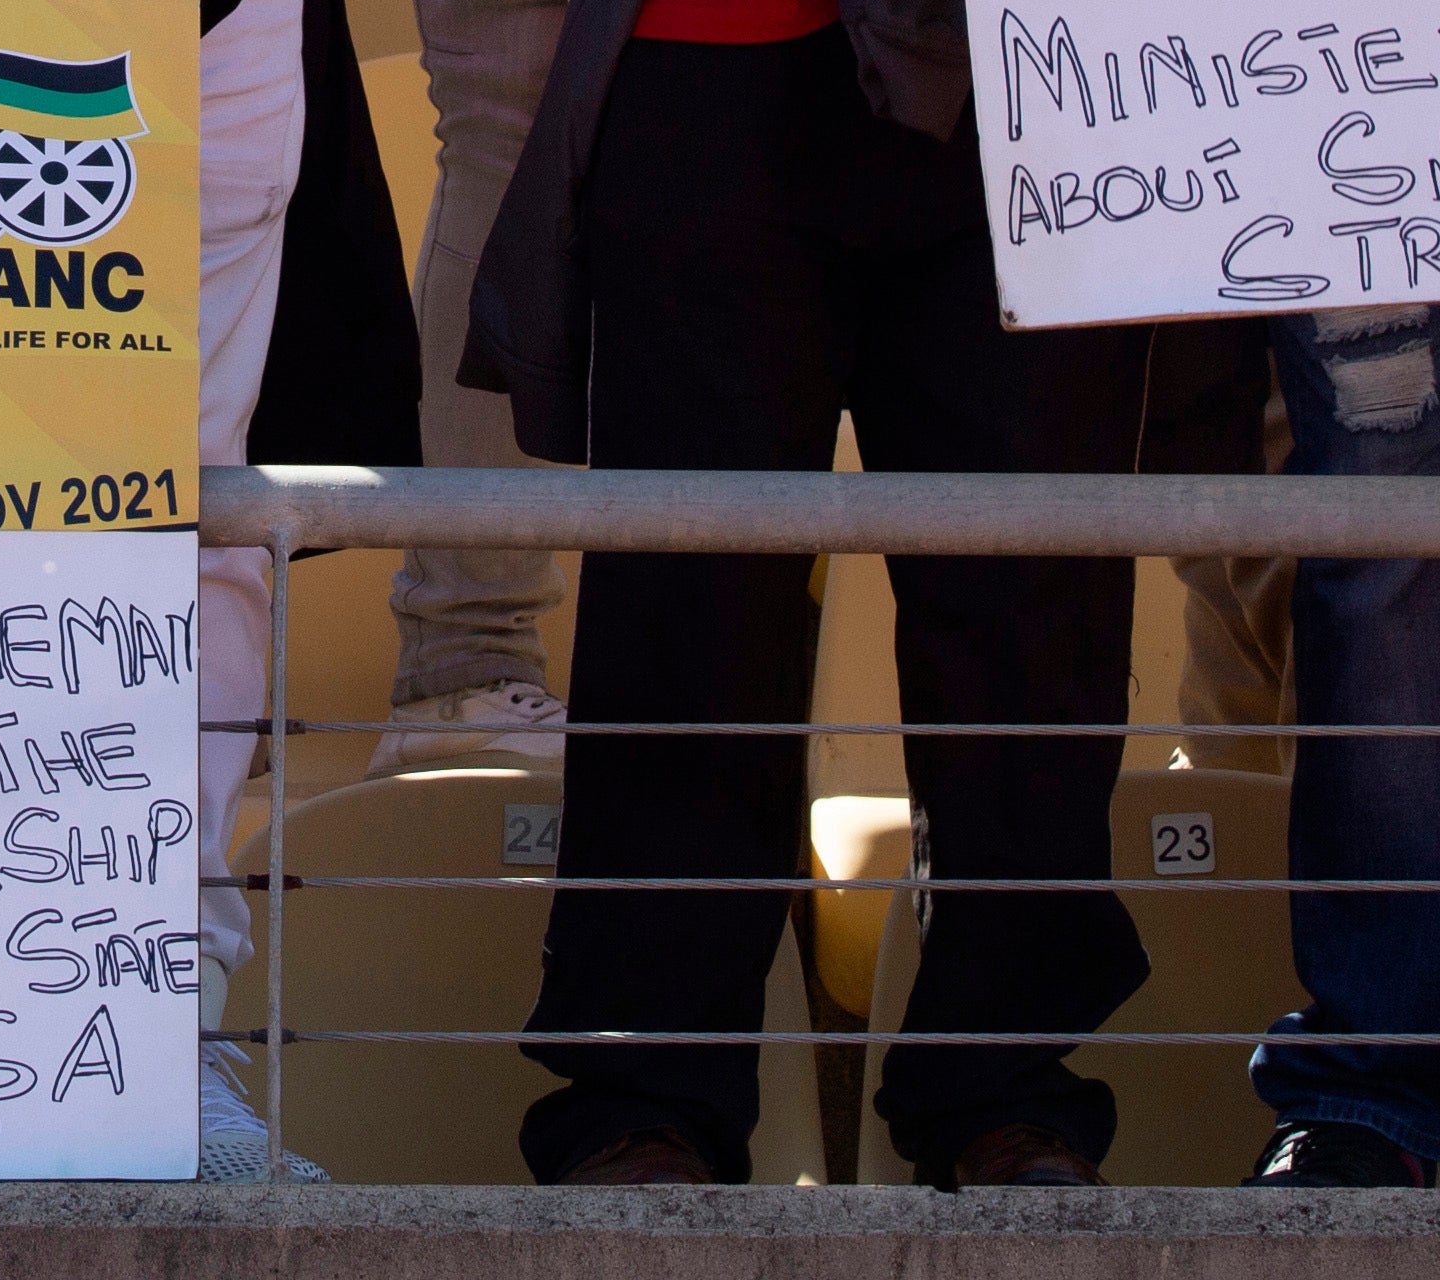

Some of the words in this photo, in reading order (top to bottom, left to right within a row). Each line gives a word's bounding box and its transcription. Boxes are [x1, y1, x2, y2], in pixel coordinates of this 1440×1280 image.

[1010, 138, 1242, 246] ABOUT
[57, 332, 112, 350] FOR
[120, 332, 172, 352] ALL
[61, 468, 179, 525] 2021
[507, 816, 560, 853] 24
[1156, 825, 1211, 862] 23
